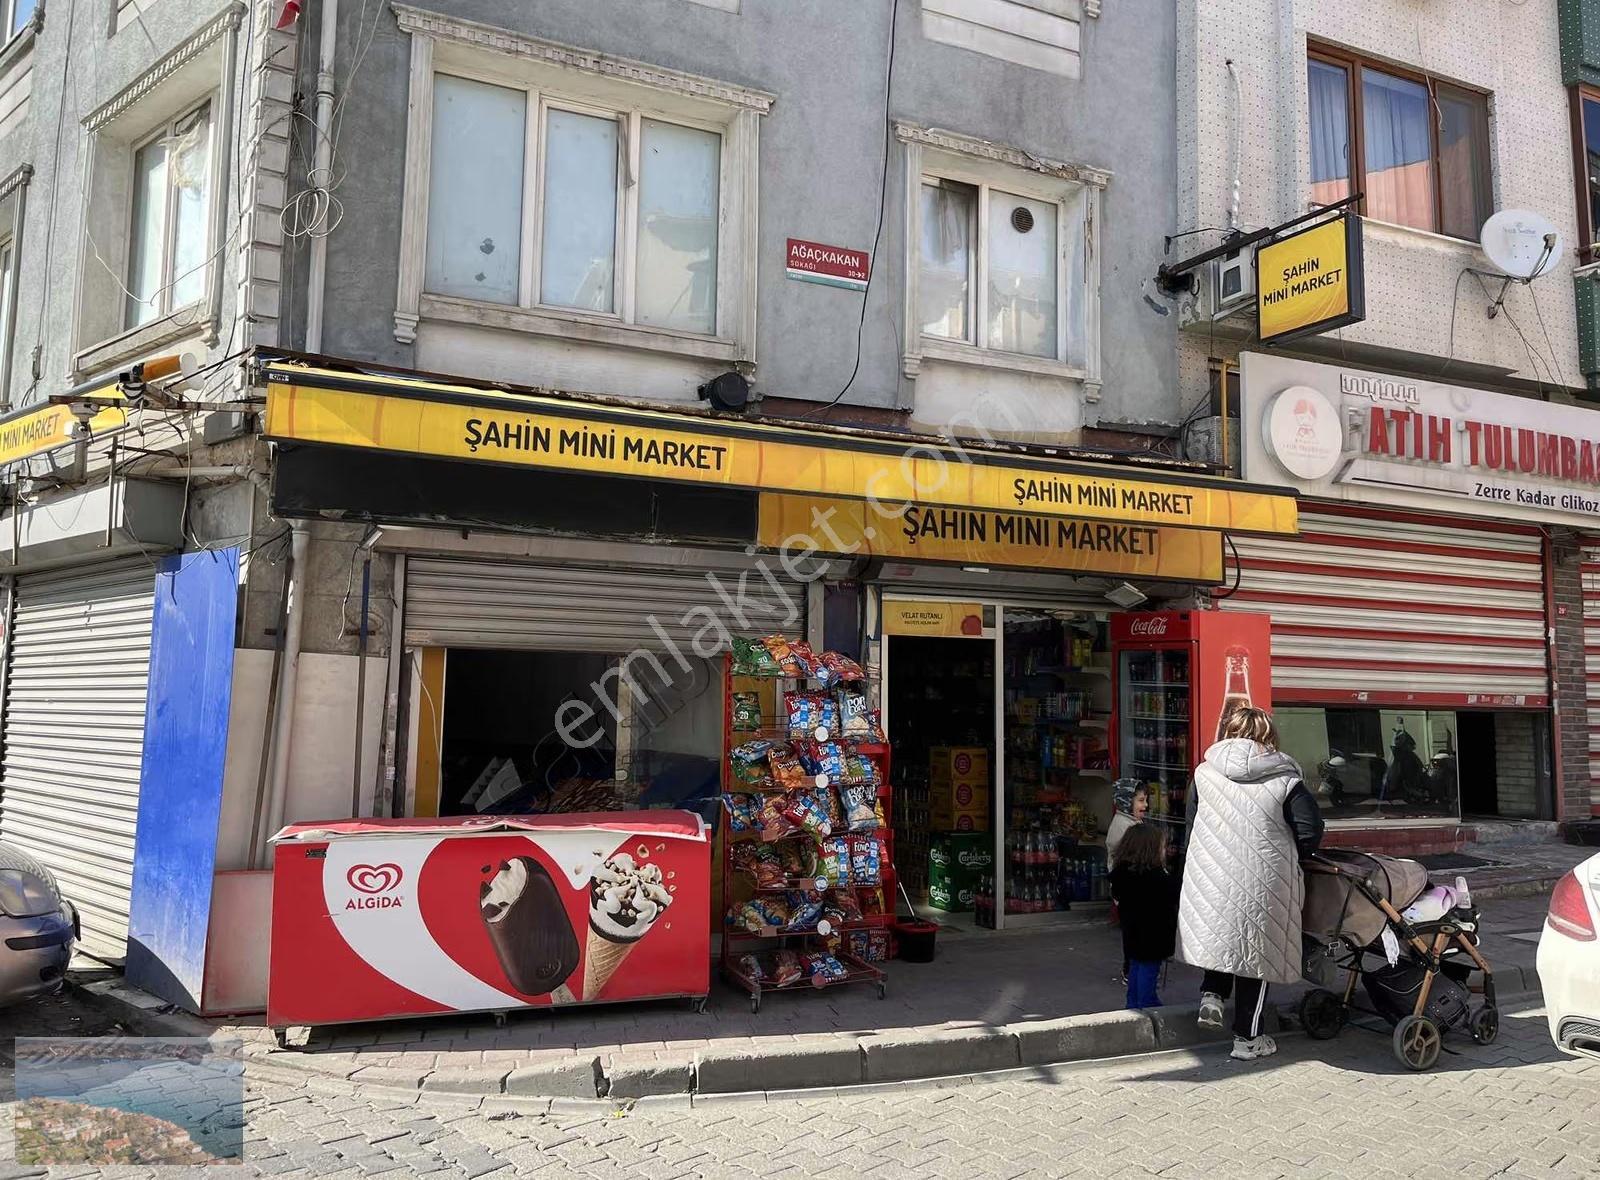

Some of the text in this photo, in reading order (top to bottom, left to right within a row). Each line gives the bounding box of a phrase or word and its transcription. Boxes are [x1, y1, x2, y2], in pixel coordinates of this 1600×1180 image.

[791, 245, 859, 267] AĞAÇKAKAN
[1283, 258, 1319, 284] ŞAHİN
[1264, 269, 1342, 306] MİNİ MARKET
[22, 413, 60, 444] MARKET
[464, 419, 727, 471] ŞAHİN MİNİ MARKET
[1465, 421, 1600, 483] TULUMBA
[1014, 477, 1193, 515] ŞAHİN MİNİ MARKET
[1475, 483, 1511, 501] Zerre
[1516, 488, 1556, 507] Kadar
[1058, 522, 1158, 555] MARKET
